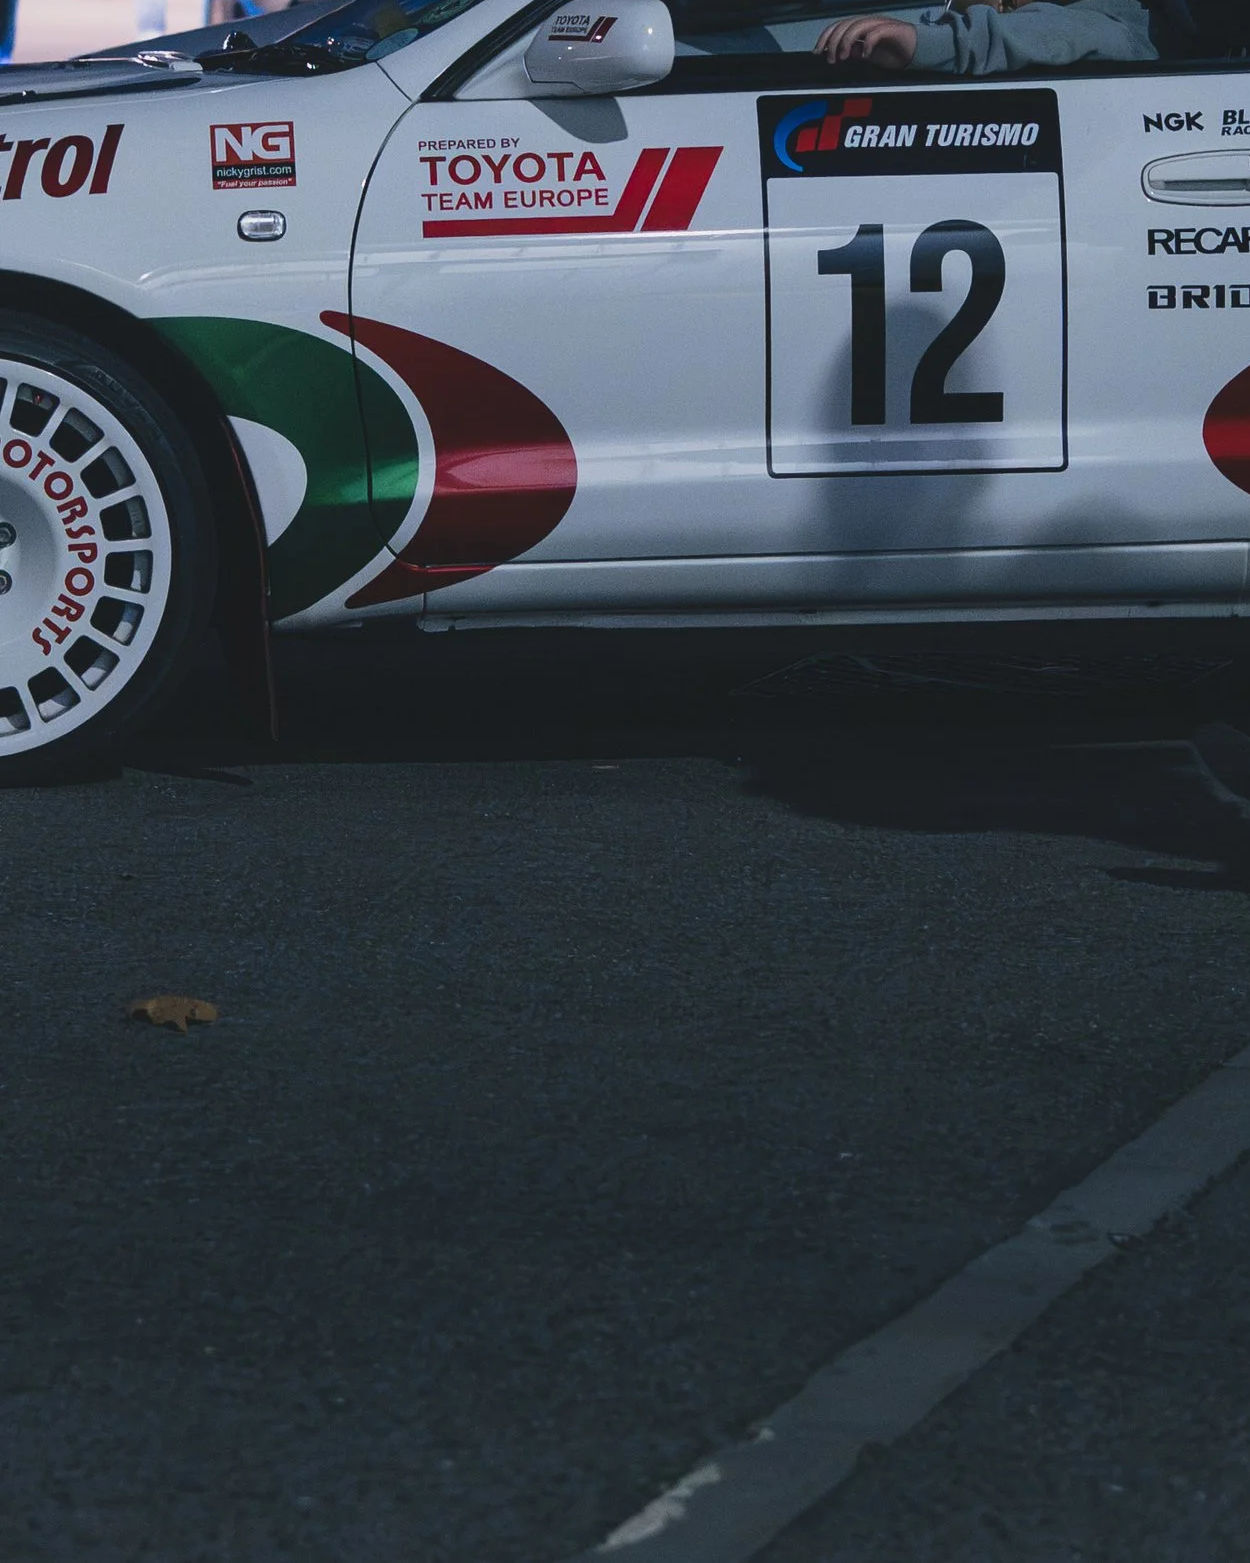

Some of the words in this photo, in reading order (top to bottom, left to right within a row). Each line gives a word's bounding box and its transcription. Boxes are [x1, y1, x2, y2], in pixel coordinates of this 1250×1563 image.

[555, 15, 590, 26] TOYOTA
[1143, 111, 1204, 133] NGK
[214, 124, 291, 162] NG
[418, 138, 496, 151] PREPARED
[500, 138, 520, 148] BY
[844, 124, 917, 148] GRAN
[925, 123, 1039, 147] TURISMO
[216, 166, 292, 178] nickygrist.com
[419, 151, 606, 186] TOYOTA
[239, 180, 257, 188] your
[421, 191, 493, 211] TEAM
[503, 188, 609, 208] EUROPE
[817, 219, 1006, 425] 12
[0, 438, 98, 656] OTORSPORTS
